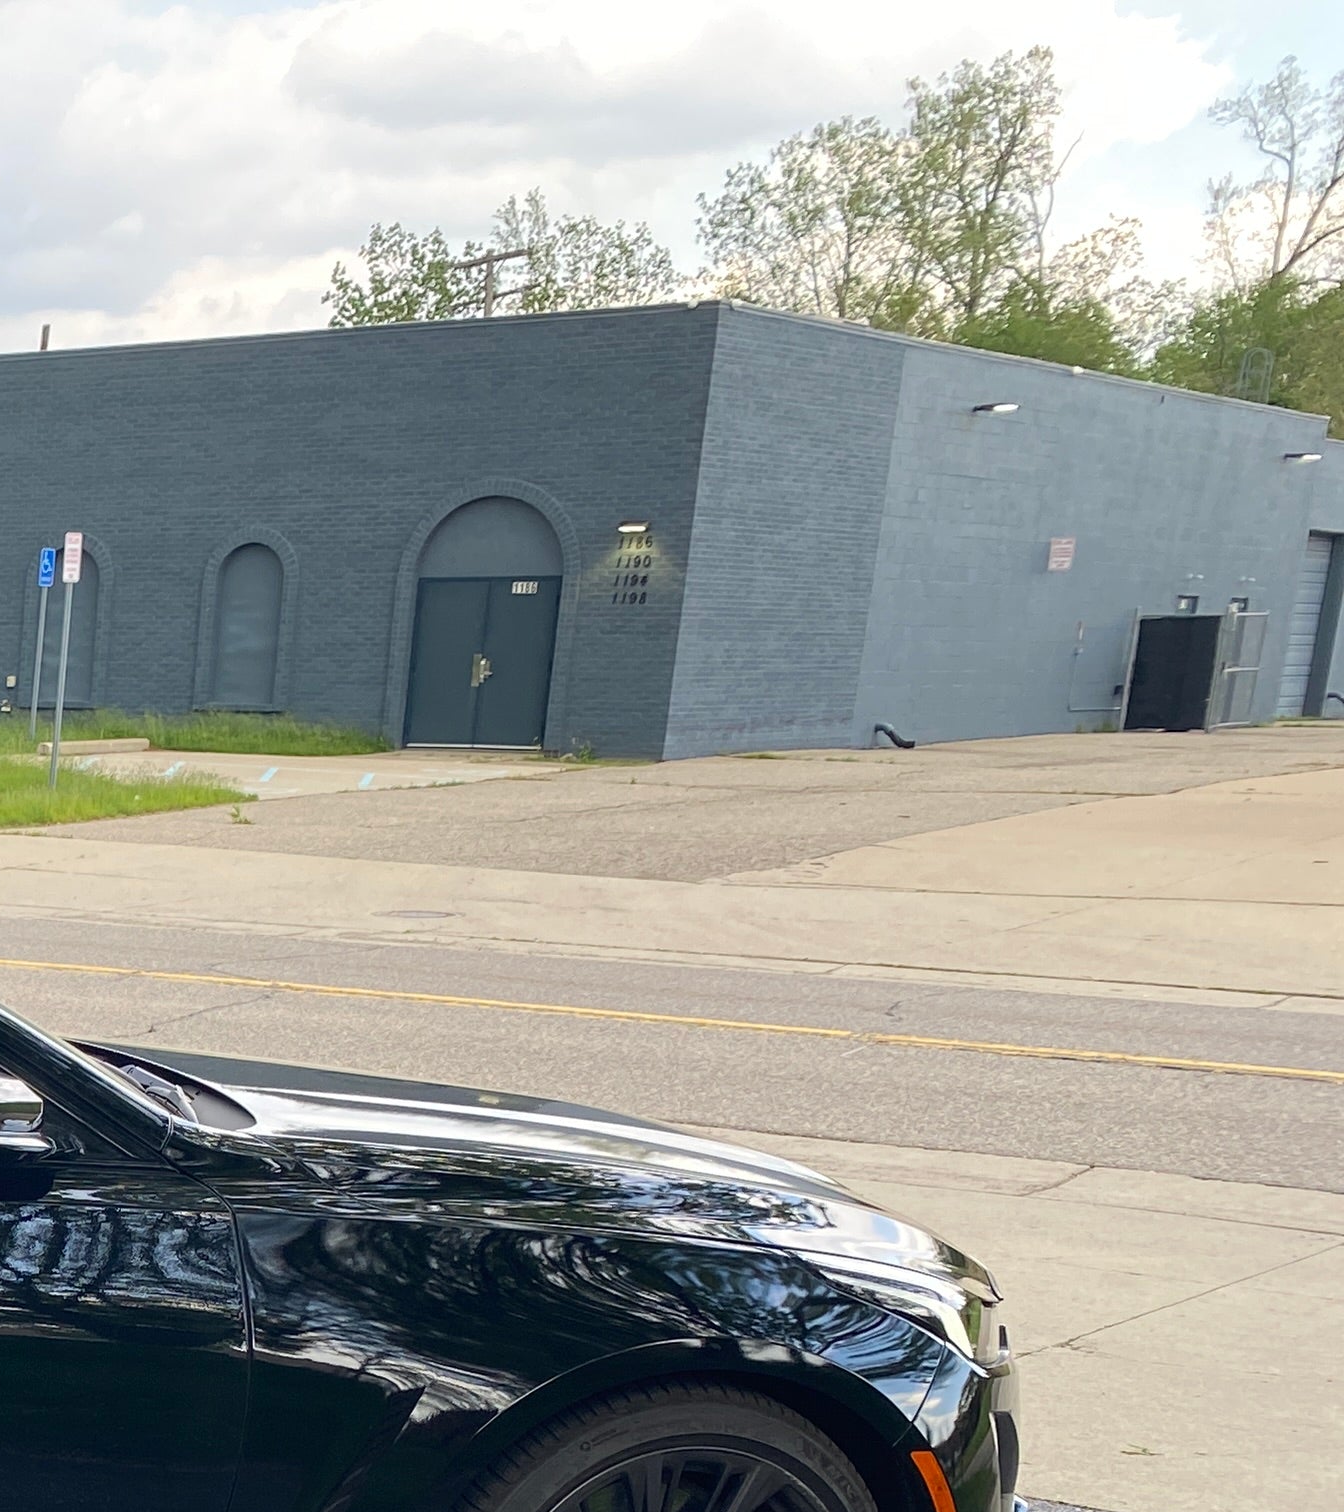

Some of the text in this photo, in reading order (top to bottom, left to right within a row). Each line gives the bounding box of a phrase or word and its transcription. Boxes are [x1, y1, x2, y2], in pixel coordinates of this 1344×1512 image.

[618, 535, 653, 550] 1186
[616, 555, 652, 569] 1190
[612, 592, 648, 605] 1198
